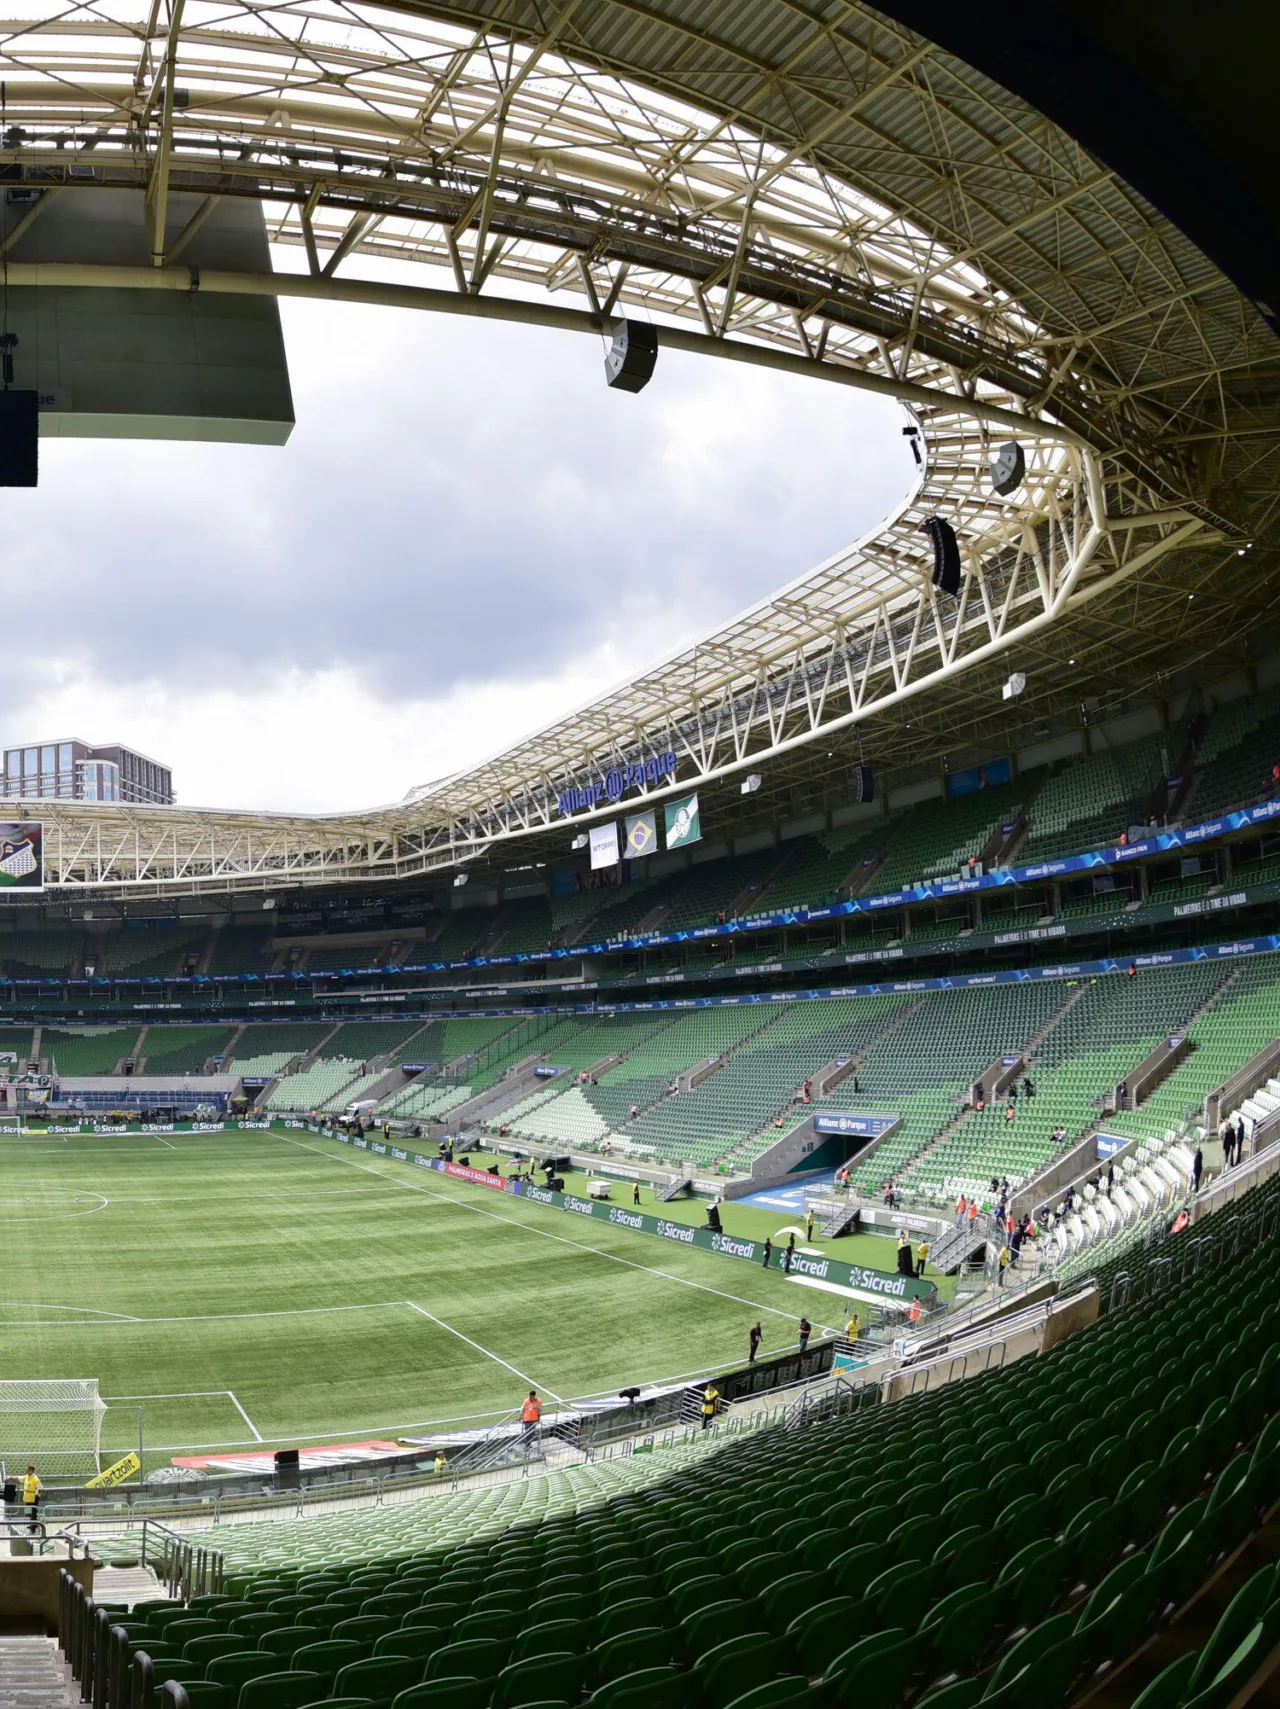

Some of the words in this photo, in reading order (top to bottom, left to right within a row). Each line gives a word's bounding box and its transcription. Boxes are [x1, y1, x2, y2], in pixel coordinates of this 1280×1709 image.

[558, 782, 604, 815] Allianz
[626, 752, 677, 787] Parque
[1252, 807, 1267, 818] Allianz
[1185, 830, 1200, 839] Allianz
[1205, 823, 1221, 834] Seguros
[1121, 847, 1136, 855] BANCO
[1025, 867, 1041, 876] Allianz
[1048, 863, 1065, 872] Seguros
[942, 884, 958, 892] Allianz
[964, 881, 979, 889] Parque
[870, 897, 883, 905] Allianz
[1173, 902, 1201, 916] PALMEIRAS
[1210, 898, 1222, 909] TIME
[1222, 896, 1229, 907] DA
[1229, 892, 1247, 905] VIRADA
[994, 932, 1019, 944] PALMEIRAS
[1028, 929, 1039, 939] TIME
[1040, 928, 1047, 938] DA
[1047, 925, 1066, 937] VIRADA
[1238, 943, 1254, 952] Seguros
[845, 953, 866, 963] PALMEIRAS
[1157, 955, 1172, 963] Parque
[1063, 966, 1080, 974] Seguros
[819, 1118, 839, 1127] Allianz
[847, 1119, 866, 1131] Parque
[448, 1165, 470, 1177] PALMEIRAS
[486, 1176, 501, 1187] SANTA
[532, 1187, 552, 1202] Sicredi
[570, 1198, 594, 1214] Sicredi
[616, 1209, 644, 1228] Sicredi
[664, 1223, 695, 1242] Sicredi
[720, 1236, 755, 1258] Sicredi
[789, 1252, 829, 1277] Sicredi
[860, 1270, 906, 1296] Sicredi
